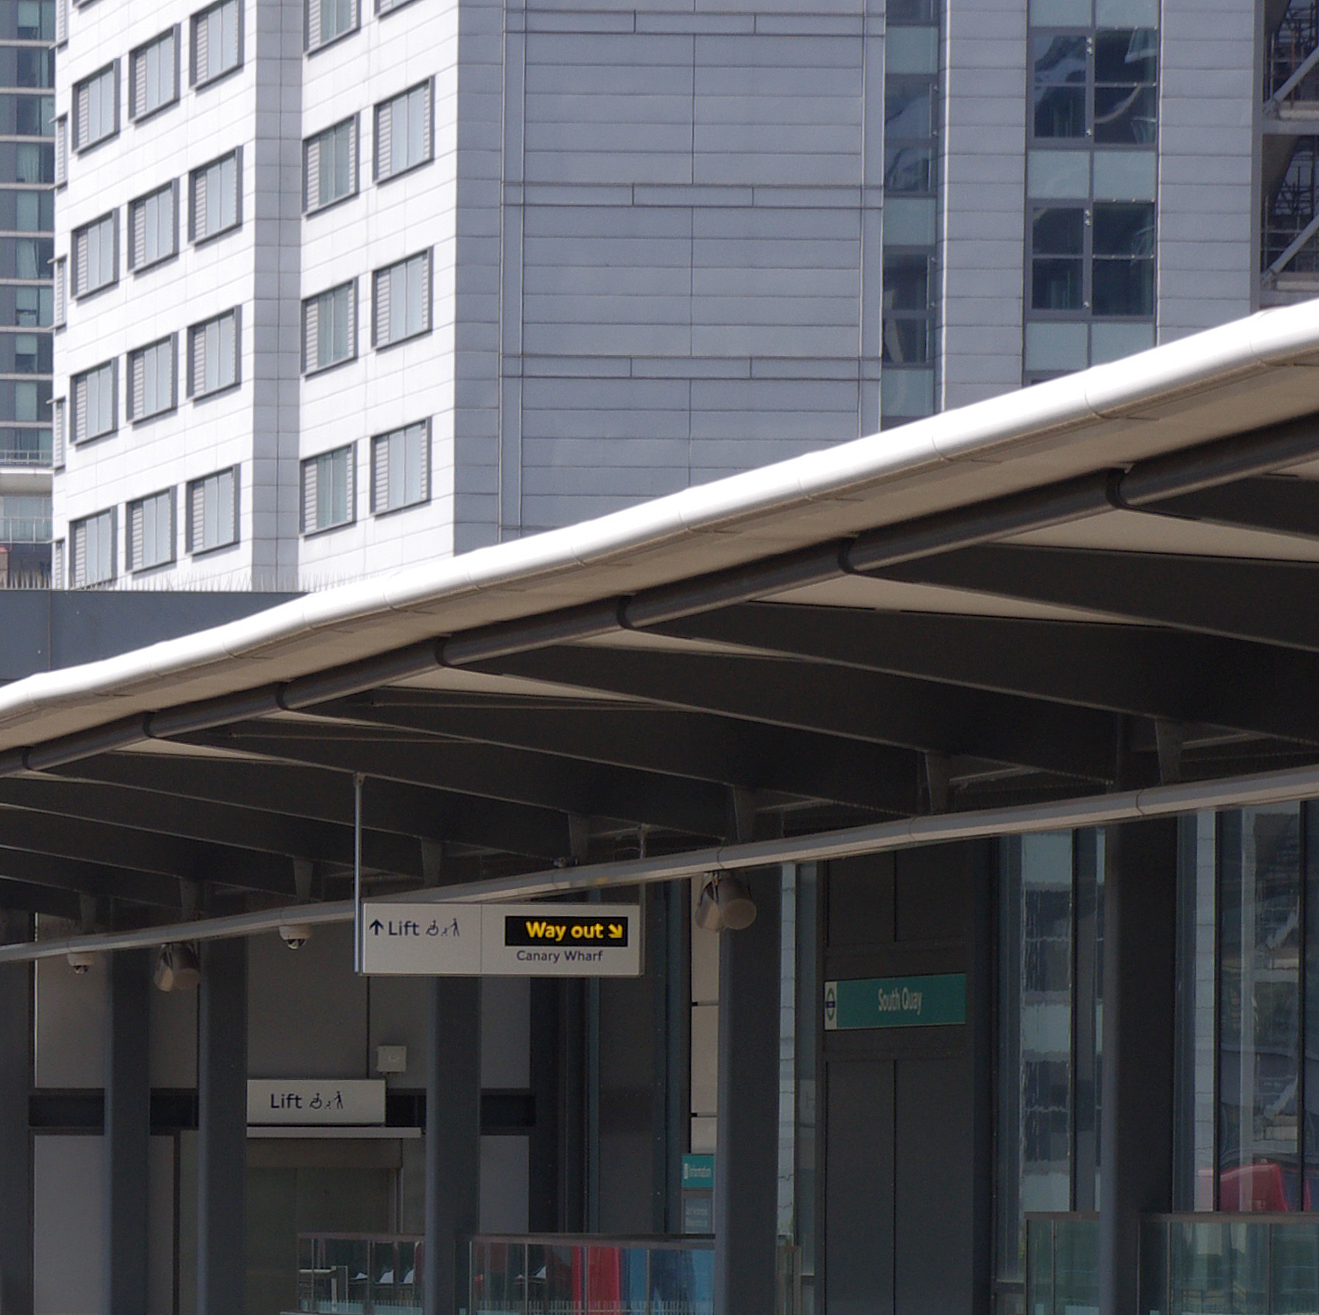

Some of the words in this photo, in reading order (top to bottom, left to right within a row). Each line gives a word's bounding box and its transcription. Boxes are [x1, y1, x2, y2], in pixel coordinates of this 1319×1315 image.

[389, 920, 419, 936] Lift
[525, 921, 566, 941] Way
[570, 923, 604, 939] out
[516, 950, 560, 963] Canary
[564, 950, 603, 962] Wharf
[877, 987, 901, 1012] South
[901, 986, 923, 1015] Quay
[270, 1093, 303, 1109] Lift
